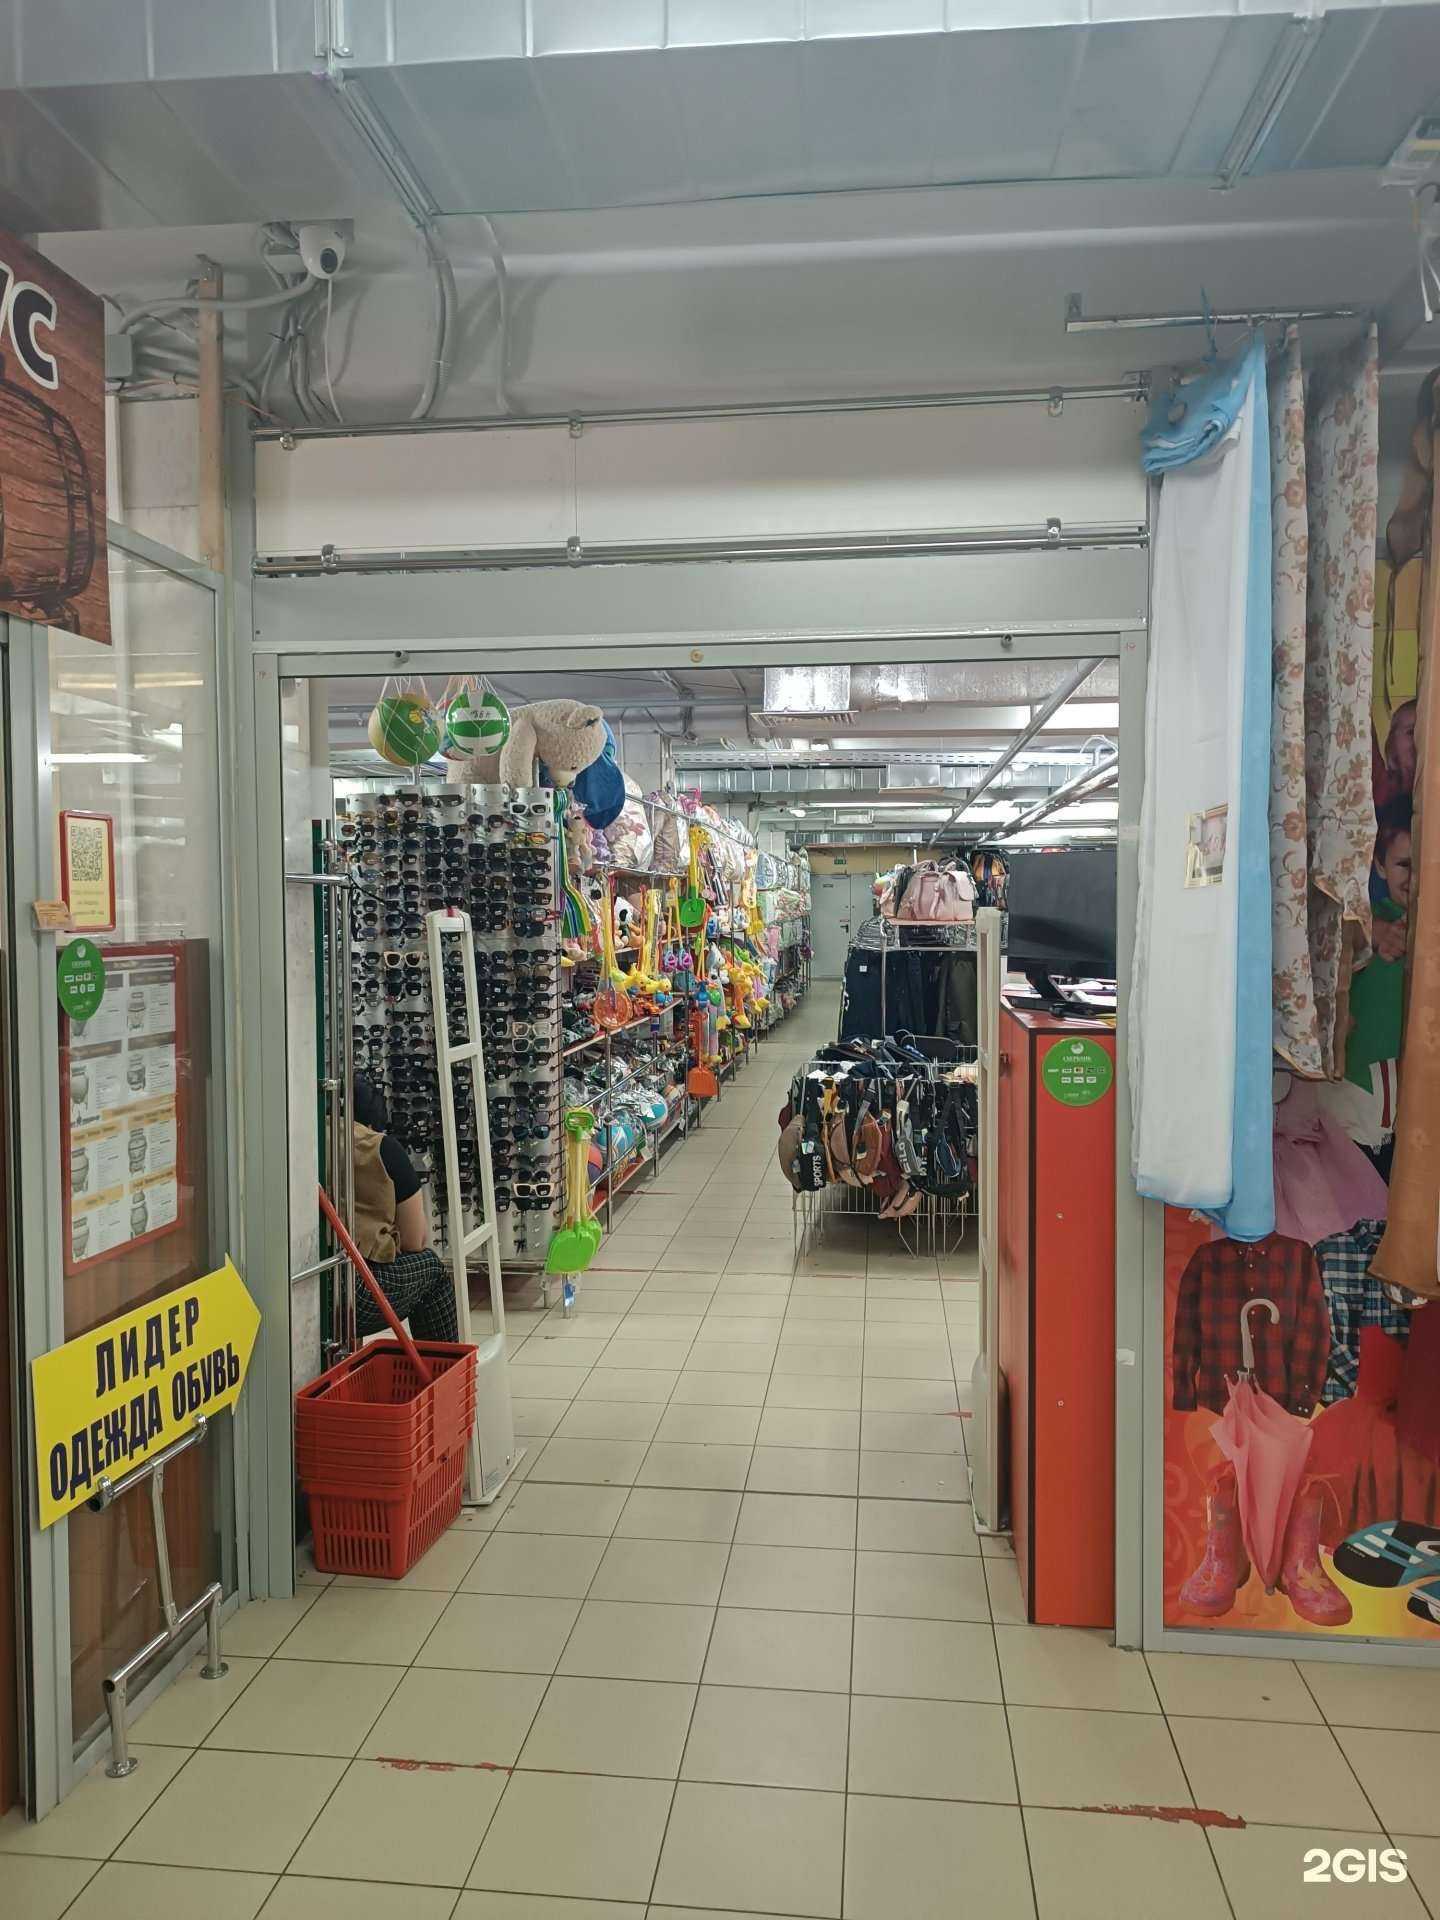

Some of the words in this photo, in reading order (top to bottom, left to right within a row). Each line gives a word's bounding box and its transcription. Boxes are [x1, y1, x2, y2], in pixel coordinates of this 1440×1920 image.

[812, 1155, 824, 1187] SPORTS
[96, 1297, 200, 1398] ЛИДЕР
[50, 1386, 163, 1501] ОДЕЖДА
[172, 1342, 240, 1421] ОБУВЬ
